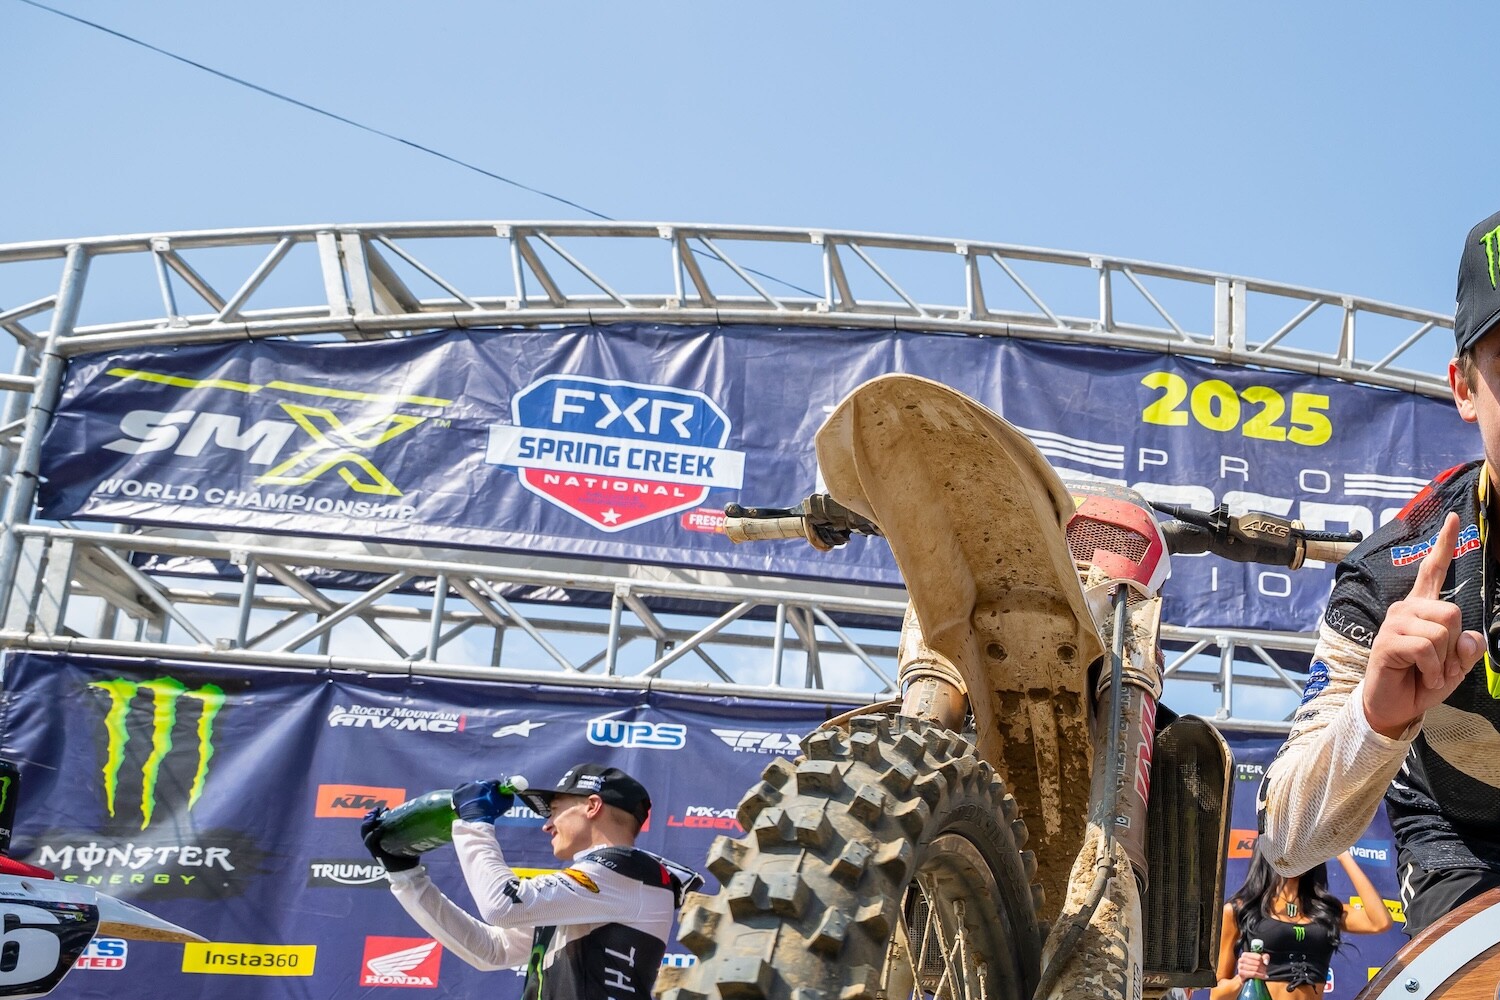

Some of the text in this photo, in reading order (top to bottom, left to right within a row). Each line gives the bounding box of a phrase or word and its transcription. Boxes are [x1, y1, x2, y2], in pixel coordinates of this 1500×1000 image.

[552, 388, 694, 438] FXR
[1141, 371, 1333, 446] 2025
[104, 402, 427, 496] SMX
[518, 436, 715, 478] SPRING CREEK
[1139, 447, 1331, 494] PRO
[543, 474, 685, 498] NATIONAL
[97, 478, 416, 520] WORLD CHAMPIONSHIP
[689, 513, 725, 527] FRESC
[1240, 519, 1290, 537] ARC
[349, 704, 460, 720] ROCKY MOUNTAIN
[591, 721, 684, 745] WPS
[733, 747, 798, 755] RACING
[331, 793, 387, 810] KTM
[686, 806, 713, 817] MX
[667, 816, 745, 833] LEGEN
[38, 843, 235, 871] MONSTER
[64, 873, 196, 885] ENERGY
[205, 950, 299, 967] Insta360
[364, 975, 434, 986] HONDA
